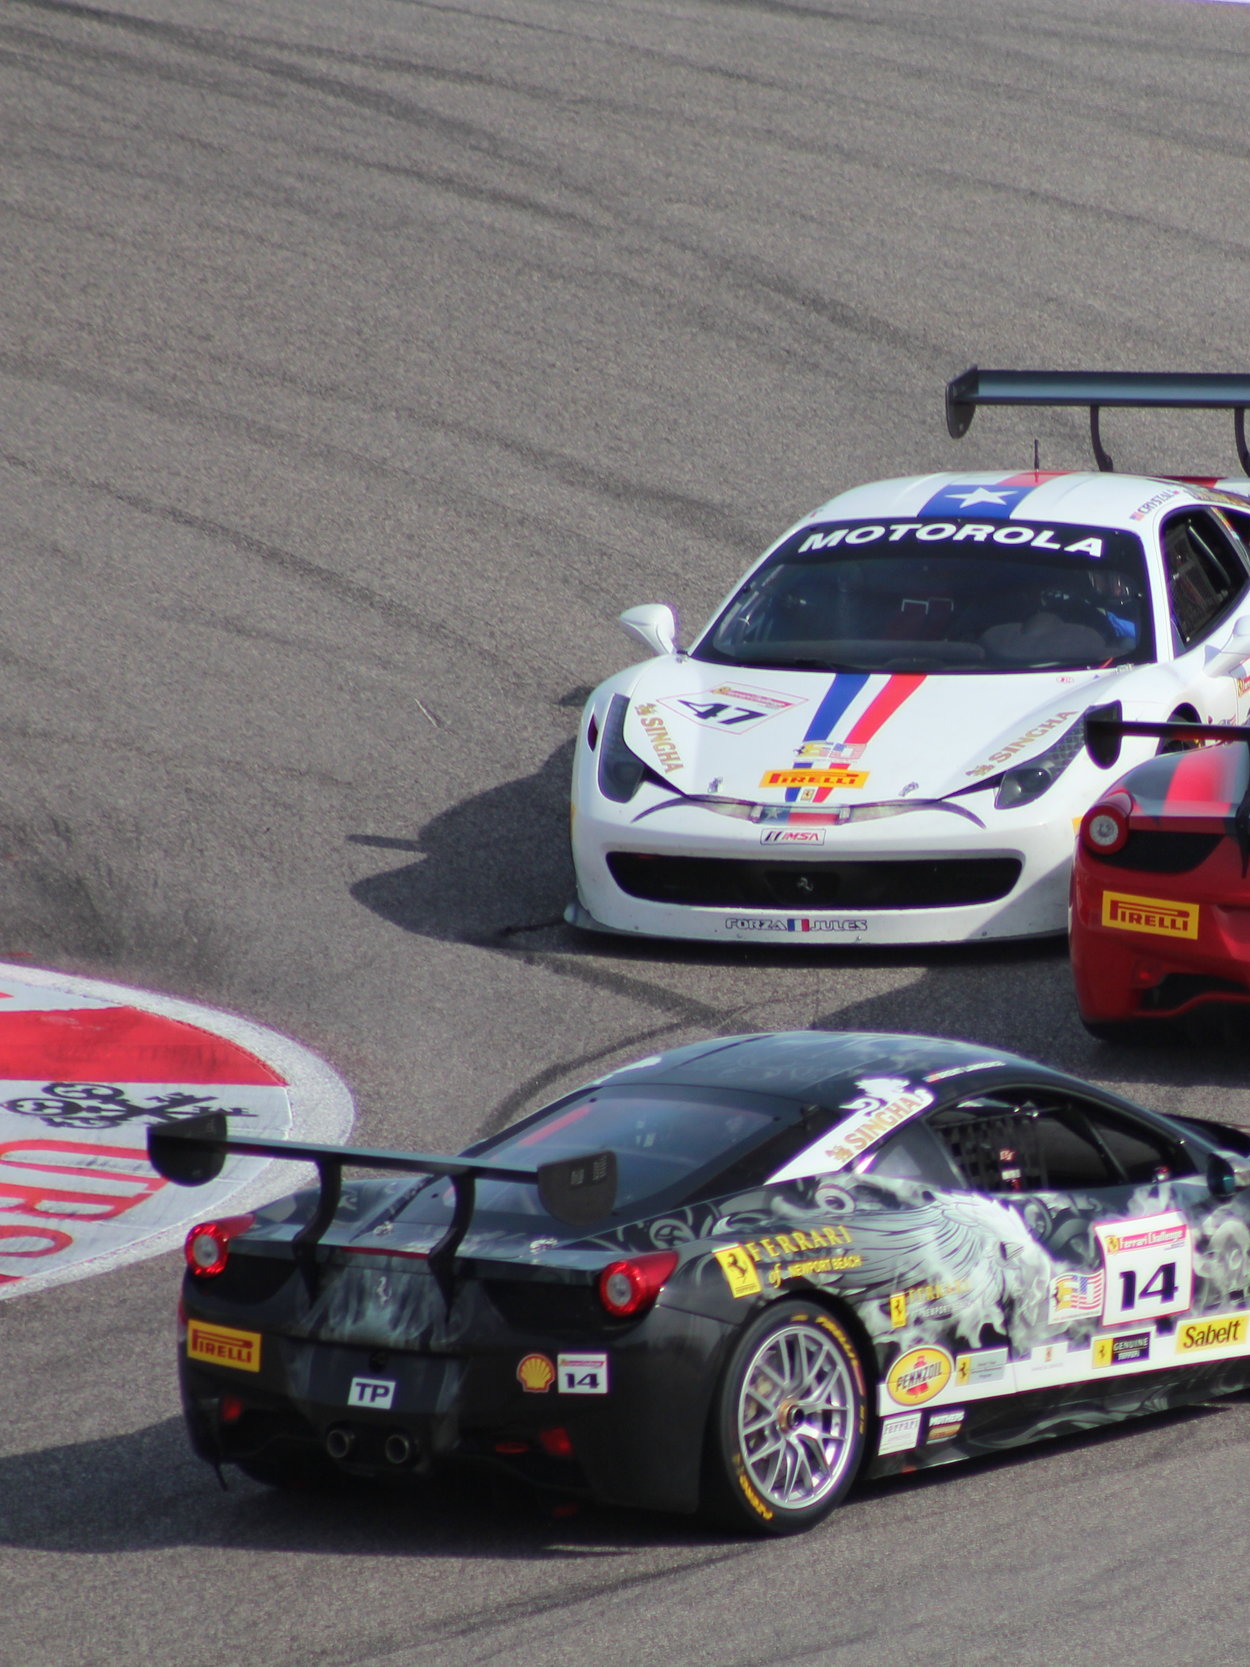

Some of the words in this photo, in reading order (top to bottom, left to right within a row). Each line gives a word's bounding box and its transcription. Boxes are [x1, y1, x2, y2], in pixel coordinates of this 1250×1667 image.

[798, 523, 1103, 557] MOTOROLA
[677, 699, 769, 725] 47
[640, 716, 684, 773] SINGHA
[988, 710, 1080, 763] SINGHA
[725, 918, 788, 931] FORZA
[809, 919, 868, 932] JULES
[1110, 899, 1190, 932] PIRELLI
[844, 1096, 923, 1150] SINGHA
[744, 1224, 853, 1262] FERRARI
[768, 1262, 782, 1289] of
[787, 1257, 832, 1278] NEWPORT
[831, 1254, 863, 1271] BEACH
[1119, 1262, 1179, 1312] 14
[192, 1329, 253, 1364] PIRELLI
[1113, 1337, 1149, 1351] GENUINE
[1184, 1320, 1241, 1349] Sabelt
[355, 1382, 390, 1403] TP
[565, 1373, 600, 1389] 14
[896, 1361, 943, 1392] PENNZOIL
